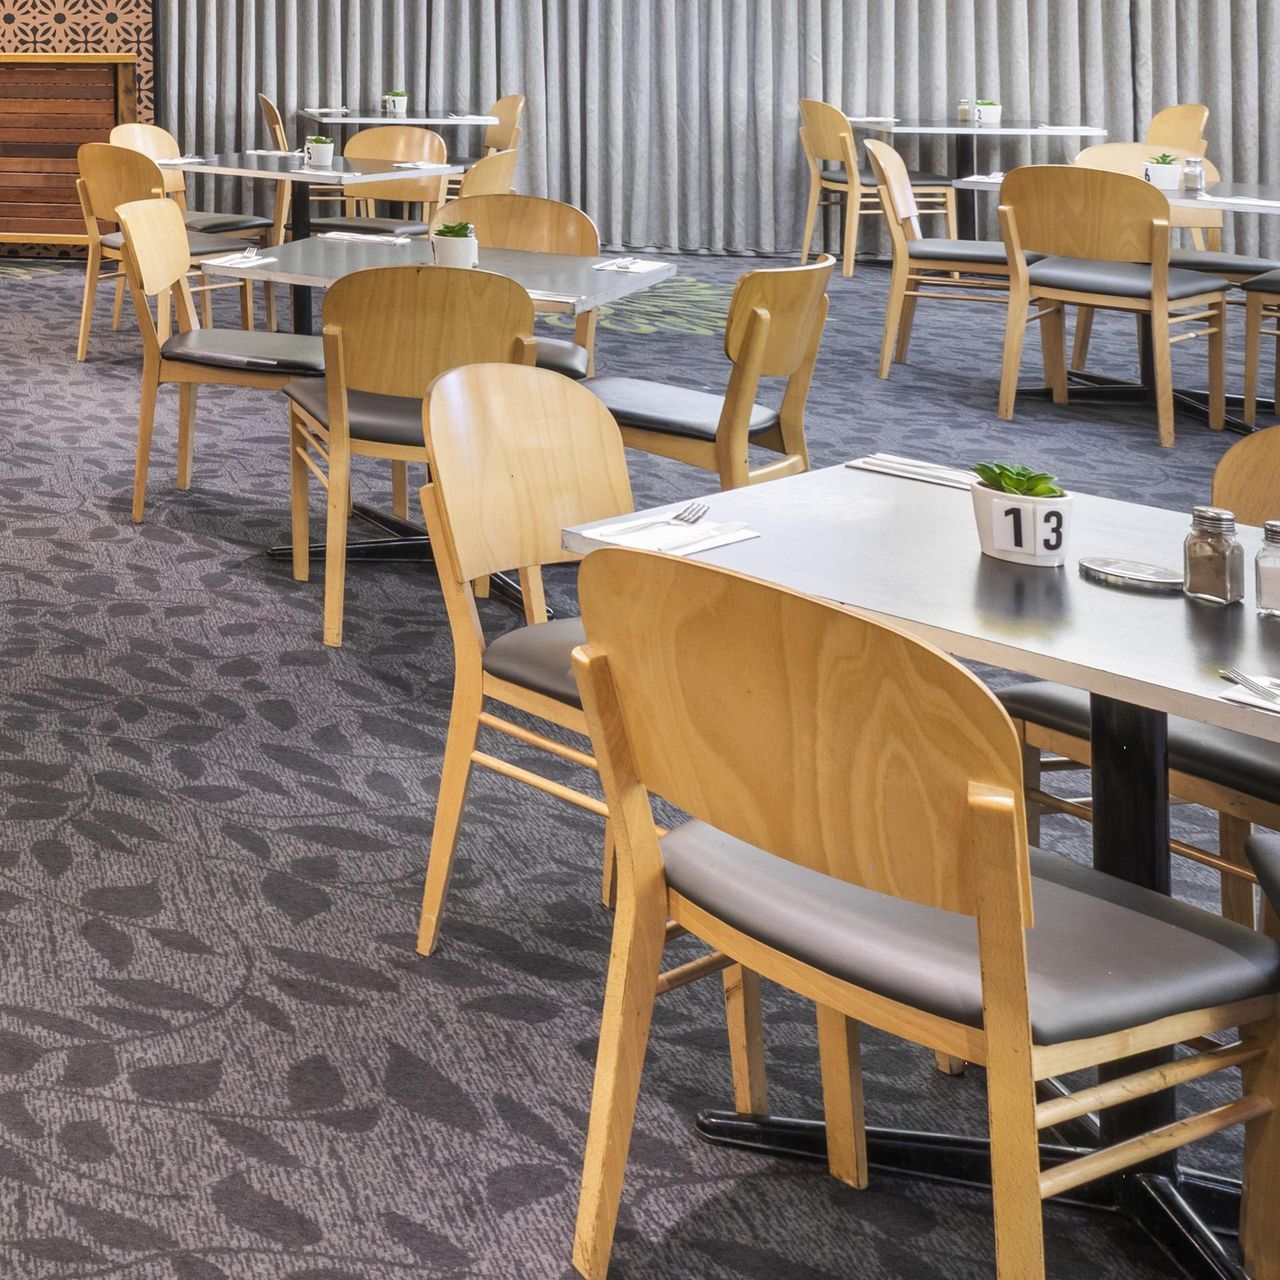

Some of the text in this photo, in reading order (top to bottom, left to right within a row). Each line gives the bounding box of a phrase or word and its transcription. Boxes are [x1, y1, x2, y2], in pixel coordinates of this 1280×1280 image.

[392, 100, 396, 109] 1
[307, 147, 312, 160] 5
[1145, 168, 1150, 182] 6
[1004, 507, 1063, 550] 13
